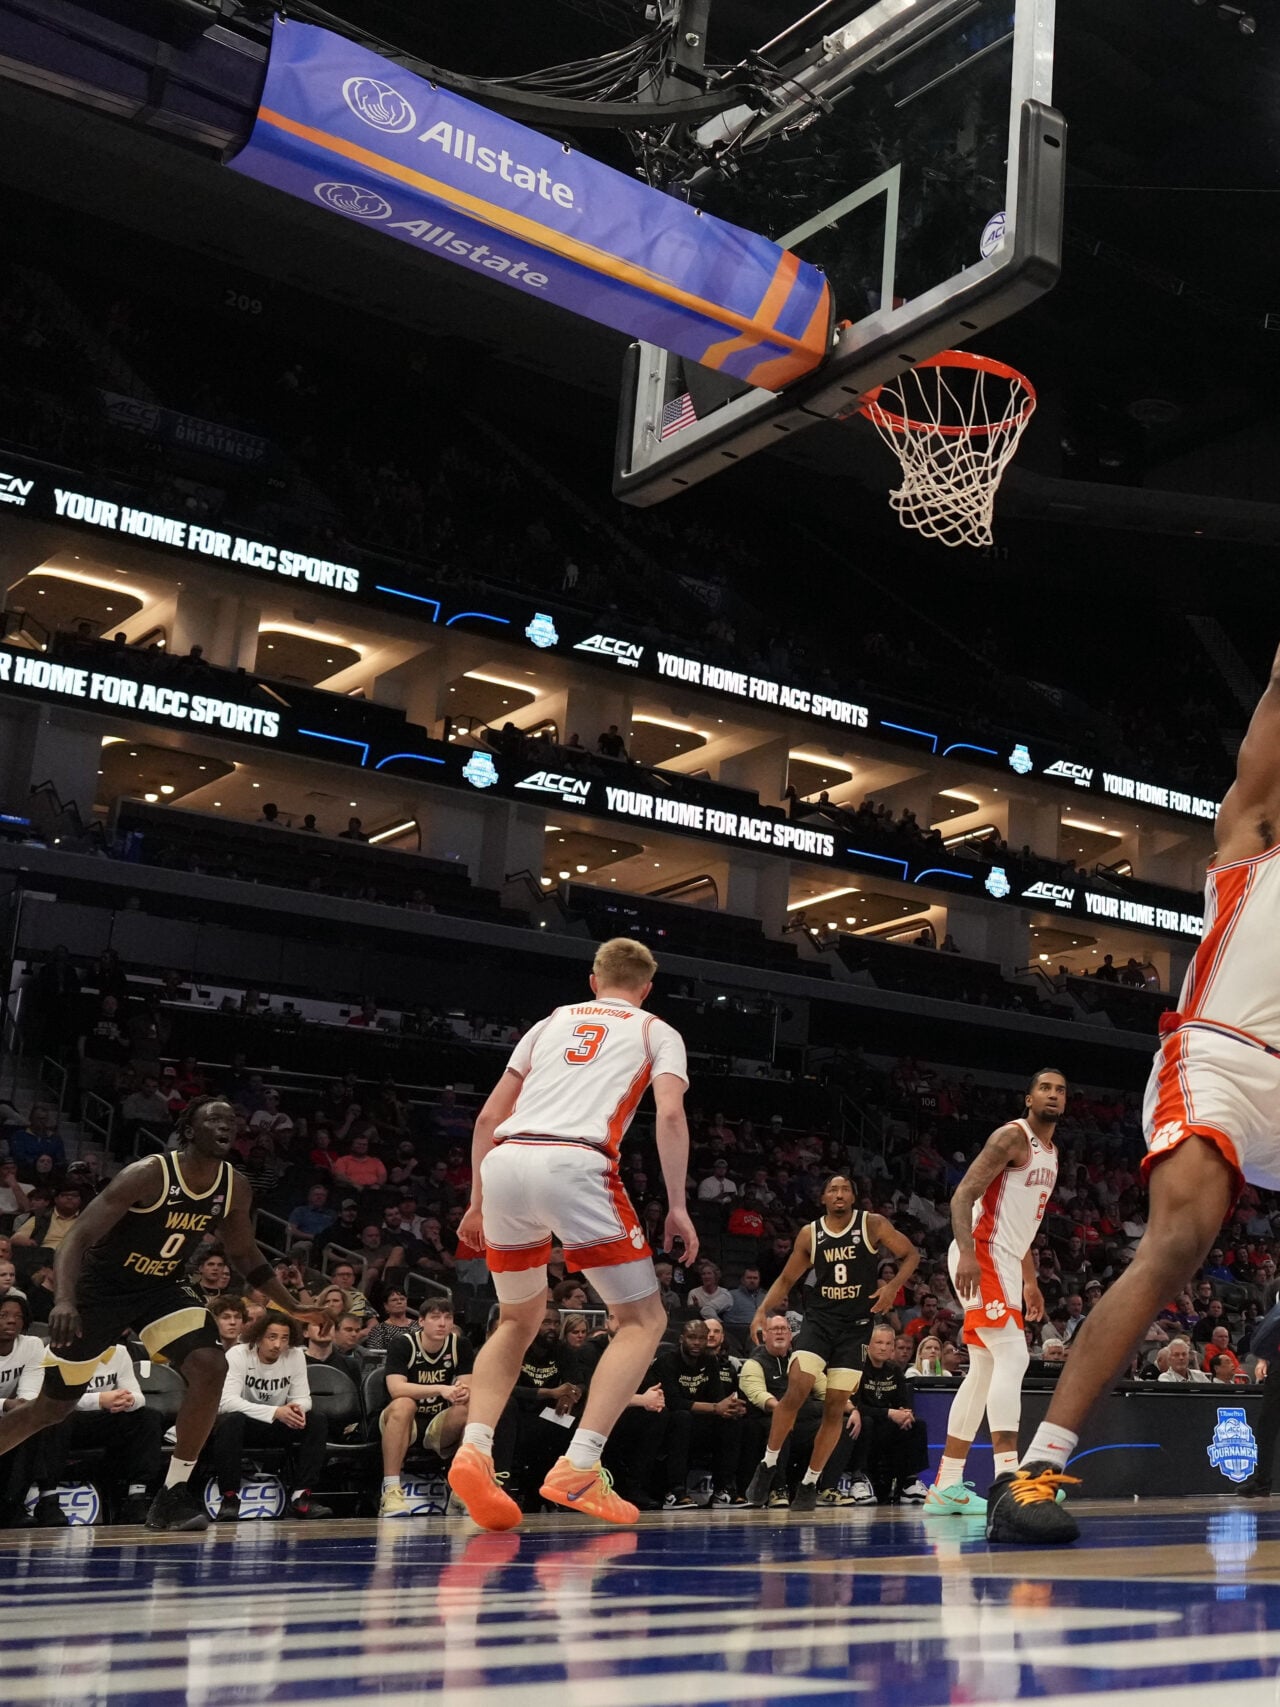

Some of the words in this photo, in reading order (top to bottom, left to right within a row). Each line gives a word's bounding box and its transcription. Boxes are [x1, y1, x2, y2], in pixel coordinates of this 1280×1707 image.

[417, 120, 575, 209] Allstate
[387, 219, 549, 287] Allstate
[225, 290, 263, 315] 209
[54, 489, 117, 529] YOUR
[120, 506, 185, 547] HOME
[188, 524, 232, 559] FOR
[232, 537, 278, 571] ACC
[277, 552, 359, 593] SPORTS
[575, 634, 644, 660] ACCN
[14, 657, 87, 698] HOME
[92, 673, 140, 710] FOR
[139, 684, 190, 718] ACC
[190, 699, 280, 738] SPORTS
[657, 652, 700, 683] YOUR
[702, 664, 747, 696] HOME
[749, 676, 778, 704] FOR
[779, 688, 813, 713] ACC
[812, 694, 868, 728] SPORTS
[1045, 760, 1093, 780] ACCN
[517, 771, 591, 796] ACCN
[1103, 772, 1136, 799] YOUR
[1136, 781, 1169, 808] HOME
[1170, 790, 1192, 814] FOR
[1192, 798, 1216, 820] ACC
[606, 786, 653, 818] YOUR
[655, 797, 704, 830] HOME
[705, 808, 739, 837] FOR
[739, 816, 775, 845] ACC
[773, 824, 835, 857] SPORTS
[1023, 881, 1075, 901] ACCN
[1085, 892, 1119, 918] YOUR
[1120, 899, 1155, 926] HOME
[1156, 906, 1179, 930] FOR
[1180, 912, 1204, 936] ACC
[569, 1006, 634, 1020] THOMPSON
[564, 1023, 609, 1065] 3
[169, 1185, 181, 1196] 54
[1036, 1191, 1047, 1222] 2
[165, 1212, 212, 1231] WAKE
[160, 1233, 186, 1259] 0
[823, 1245, 857, 1263] WAKE
[123, 1252, 183, 1276] FORES
[834, 1263, 848, 1285] 8
[821, 1284, 862, 1300] FOREST
[245, 1374, 269, 1390] LOCK
[418, 1369, 446, 1383] WAKE
